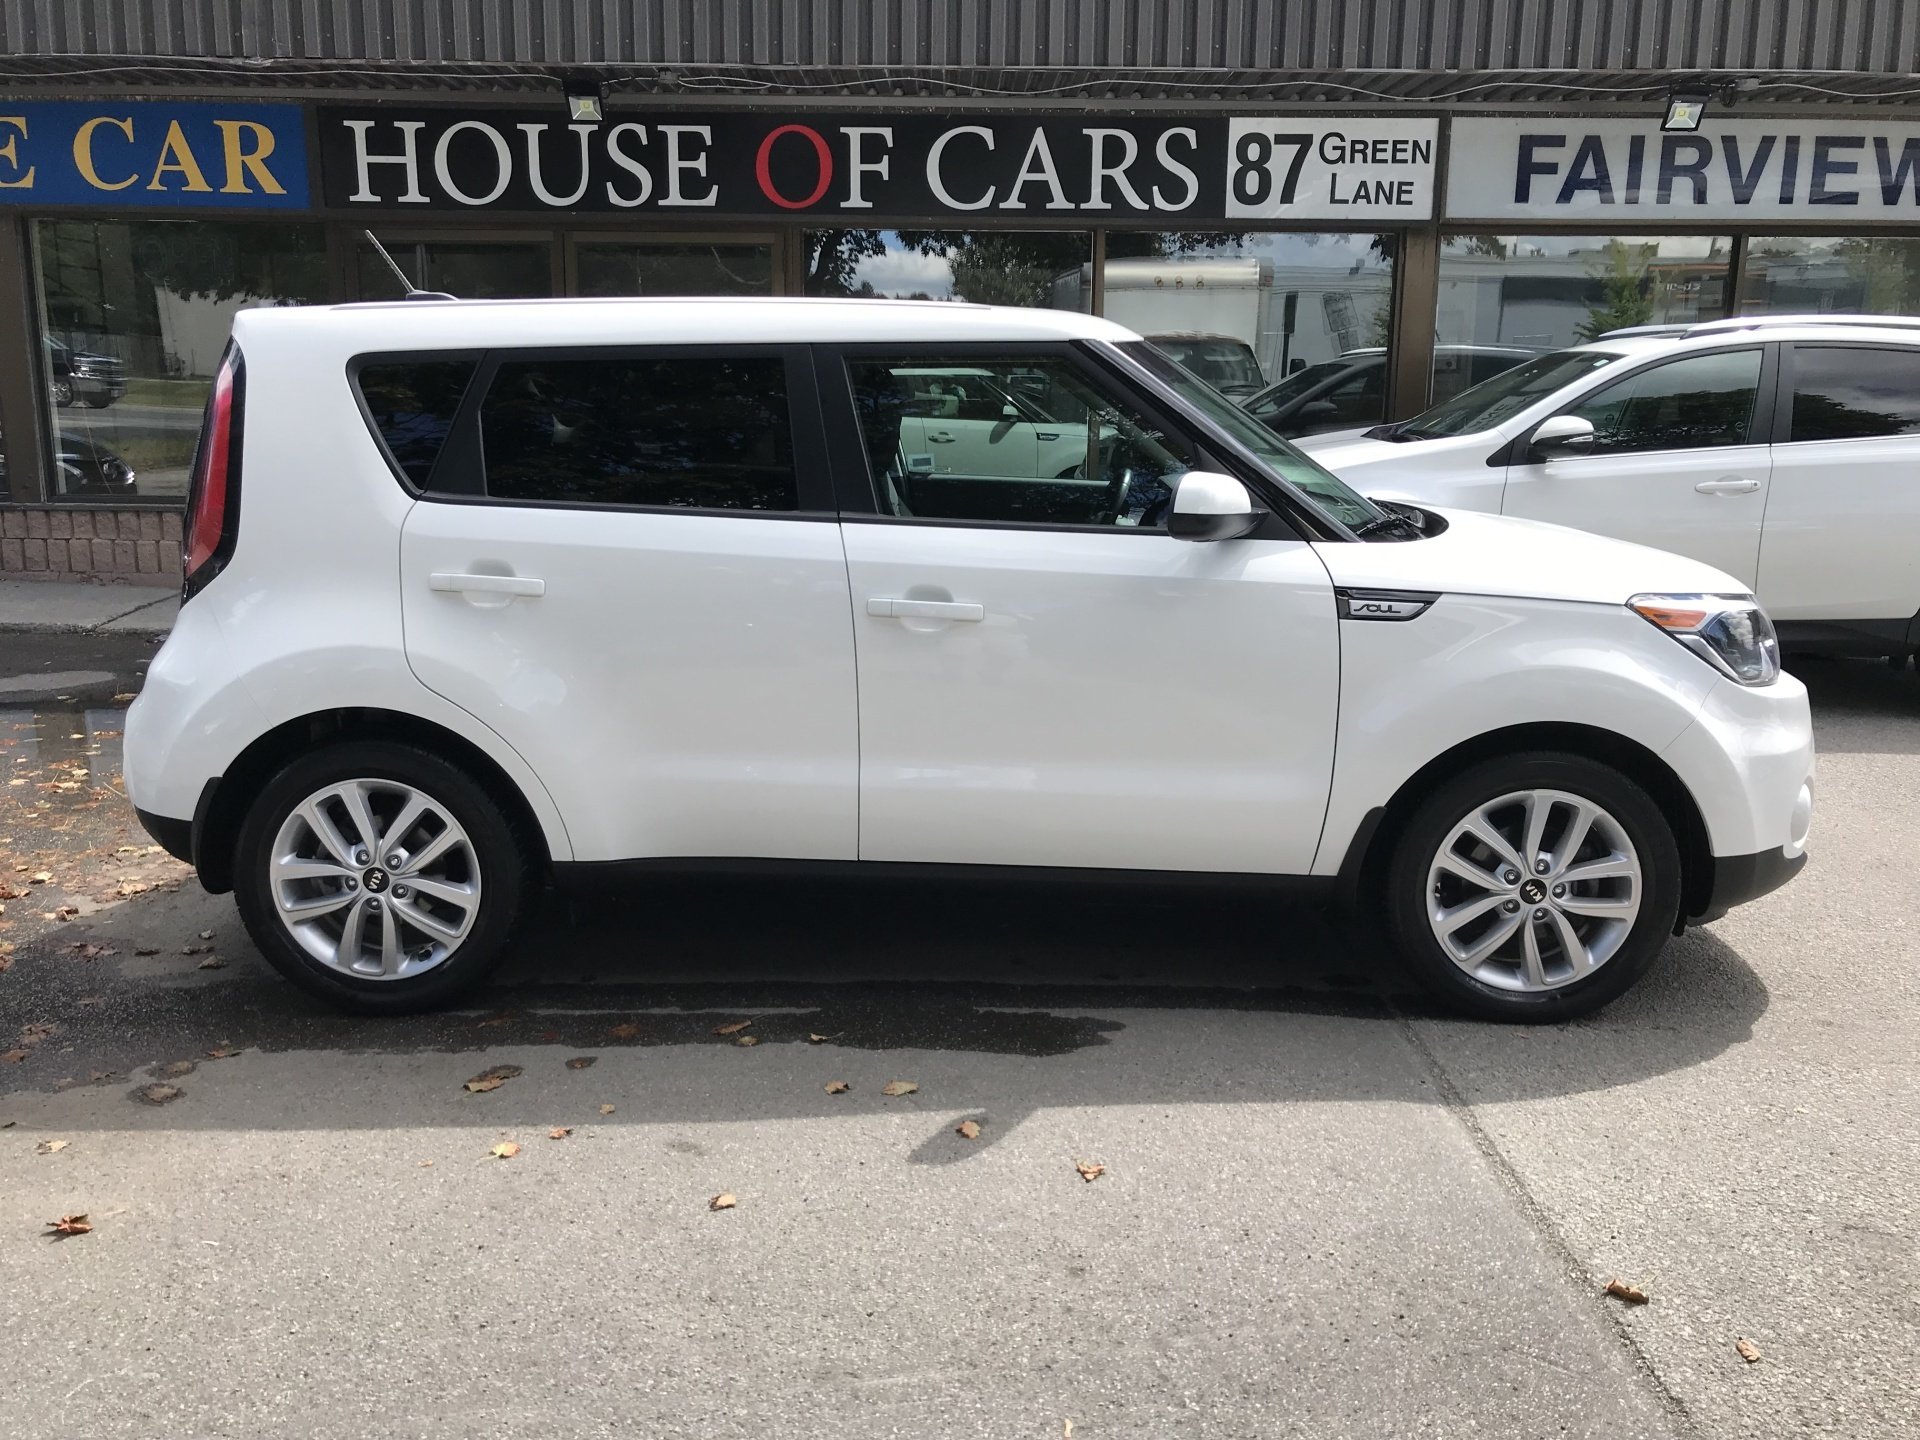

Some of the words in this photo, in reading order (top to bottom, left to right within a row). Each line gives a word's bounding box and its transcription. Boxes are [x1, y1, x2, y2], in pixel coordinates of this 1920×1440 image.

[73, 116, 287, 195] CAR
[343, 120, 719, 208] HOUSE
[755, 124, 894, 210] OF
[926, 125, 1199, 212] CARS
[1232, 132, 1314, 205] 87
[1318, 131, 1432, 165] GREEN
[1329, 172, 1415, 206] LANE
[1353, 603, 1402, 614] SOUL
[368, 870, 384, 890] KIA
[1525, 882, 1544, 902] KIA
